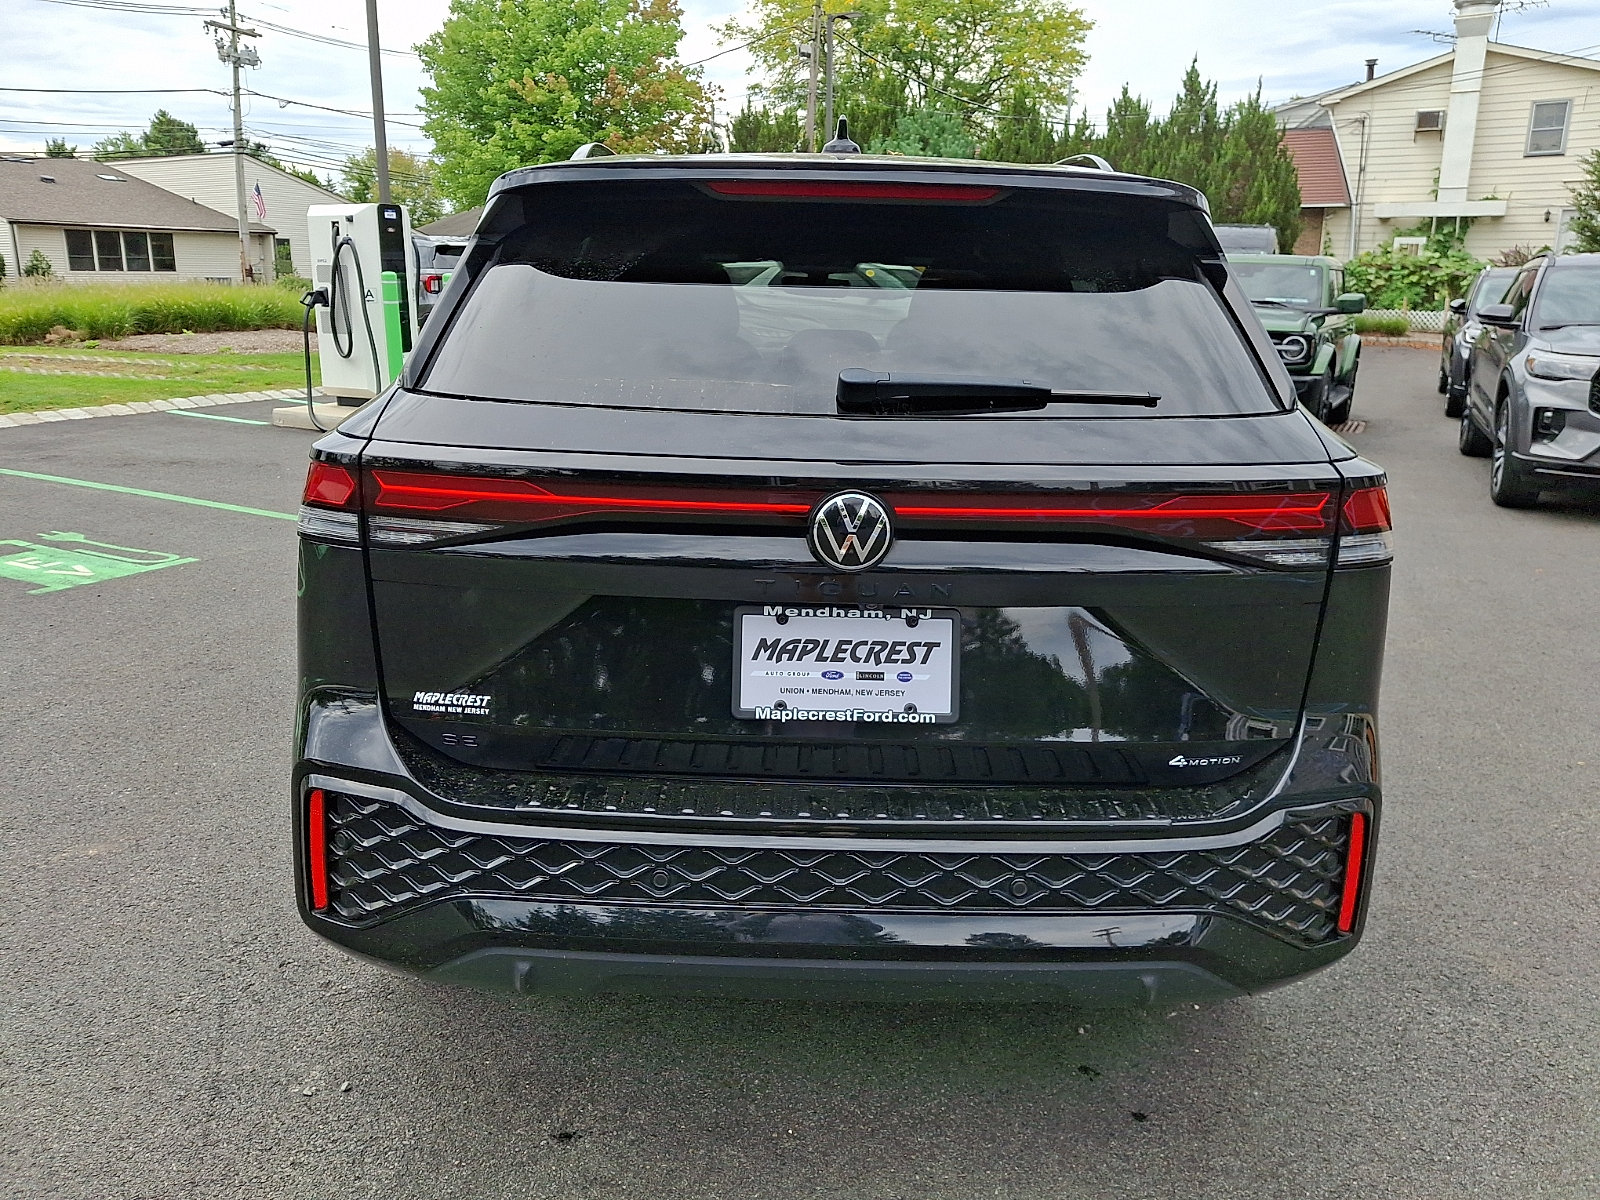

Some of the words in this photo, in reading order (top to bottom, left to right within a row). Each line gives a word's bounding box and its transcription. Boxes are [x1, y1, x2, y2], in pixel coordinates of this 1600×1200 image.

[753, 579, 952, 598] TIGUAN
[763, 605, 891, 620] Mendham,
[901, 608, 932, 620] NJ
[751, 637, 942, 667] MAPLECREST
[413, 691, 492, 707] MAPLECREST
[780, 687, 805, 695] UNION
[811, 688, 854, 697] MENDHAM,
[855, 689, 874, 697] NEW
[874, 689, 906, 697] JERSEY
[413, 703, 446, 713] MENDHAM
[447, 706, 463, 714] NEW
[463, 707, 490, 715] JERSEY
[755, 707, 936, 724] MaplecrestFord.com
[442, 733, 478, 747] SE
